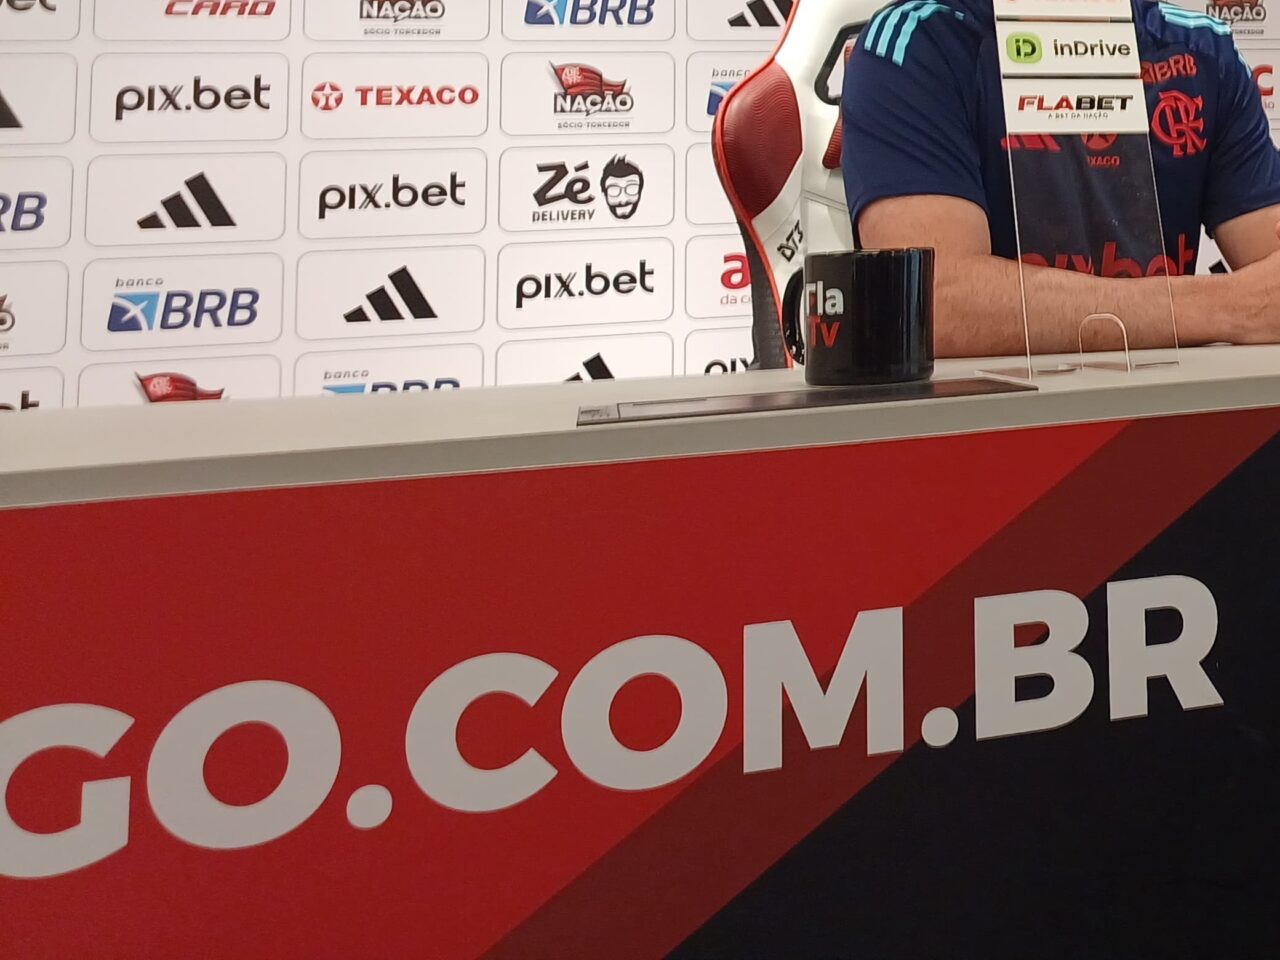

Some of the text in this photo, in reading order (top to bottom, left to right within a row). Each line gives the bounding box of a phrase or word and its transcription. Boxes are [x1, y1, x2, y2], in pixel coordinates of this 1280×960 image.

[1053, 39, 1131, 56] inDrive
[115, 75, 271, 121] pix.bet
[355, 85, 479, 107] TEXACO
[554, 89, 634, 117] NAÇÃO
[1018, 95, 1133, 111] FLABET
[318, 172, 466, 219] pix.bet
[533, 161, 595, 205] Zé
[532, 207, 595, 222] DELIVERY
[115, 275, 164, 287] banco
[515, 260, 655, 308] pix.bet
[159, 288, 260, 330] BRB
[323, 369, 369, 380] banco
